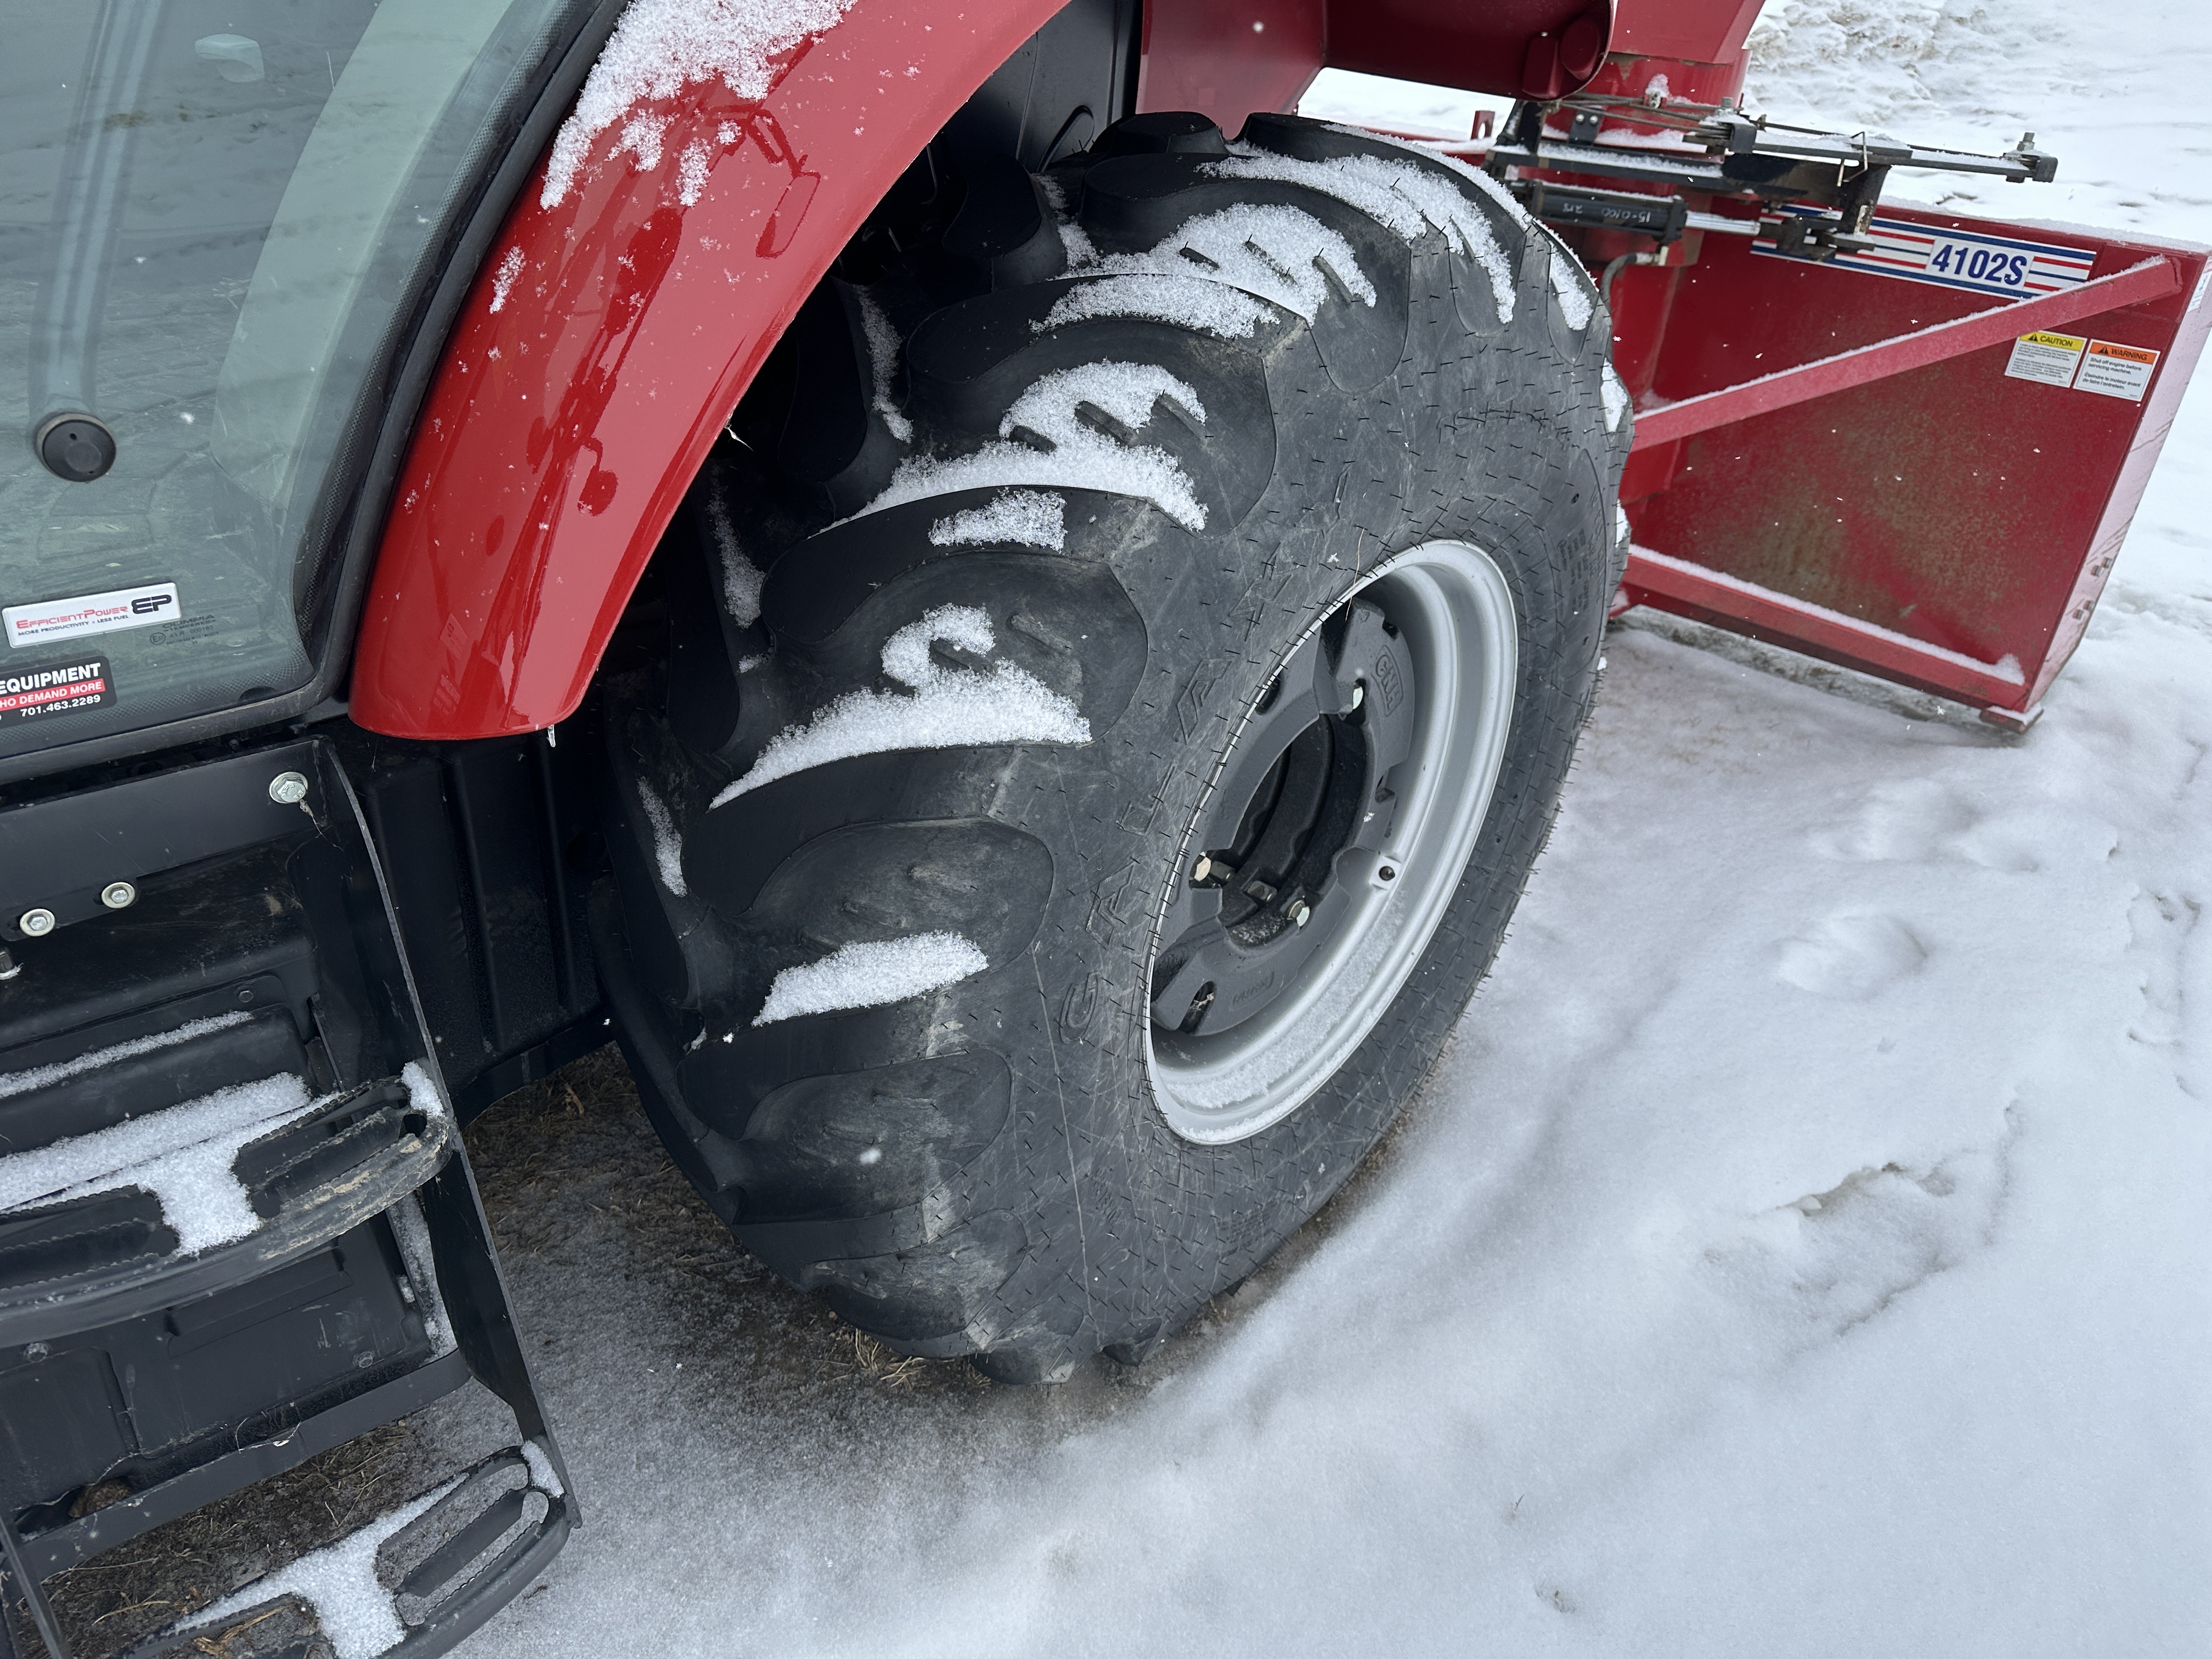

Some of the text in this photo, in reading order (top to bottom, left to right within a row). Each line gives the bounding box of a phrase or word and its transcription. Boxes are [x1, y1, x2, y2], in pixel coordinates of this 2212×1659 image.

[1601, 207, 1651, 223] 15-0100
[1932, 244, 2027, 285] 4102S
[2040, 335, 2073, 347] CAUTION
[2111, 348, 2147, 360] WARNING
[131, 594, 172, 614] EP
[41, 621, 89, 632] PRODUCTIVITY
[162, 614, 216, 629] OLIMPIA
[0, 663, 101, 695] EQUIPMENT
[19, 689, 67, 704] DEMAND
[70, 681, 102, 695] MORE
[20, 695, 101, 717] 701.463.2289
